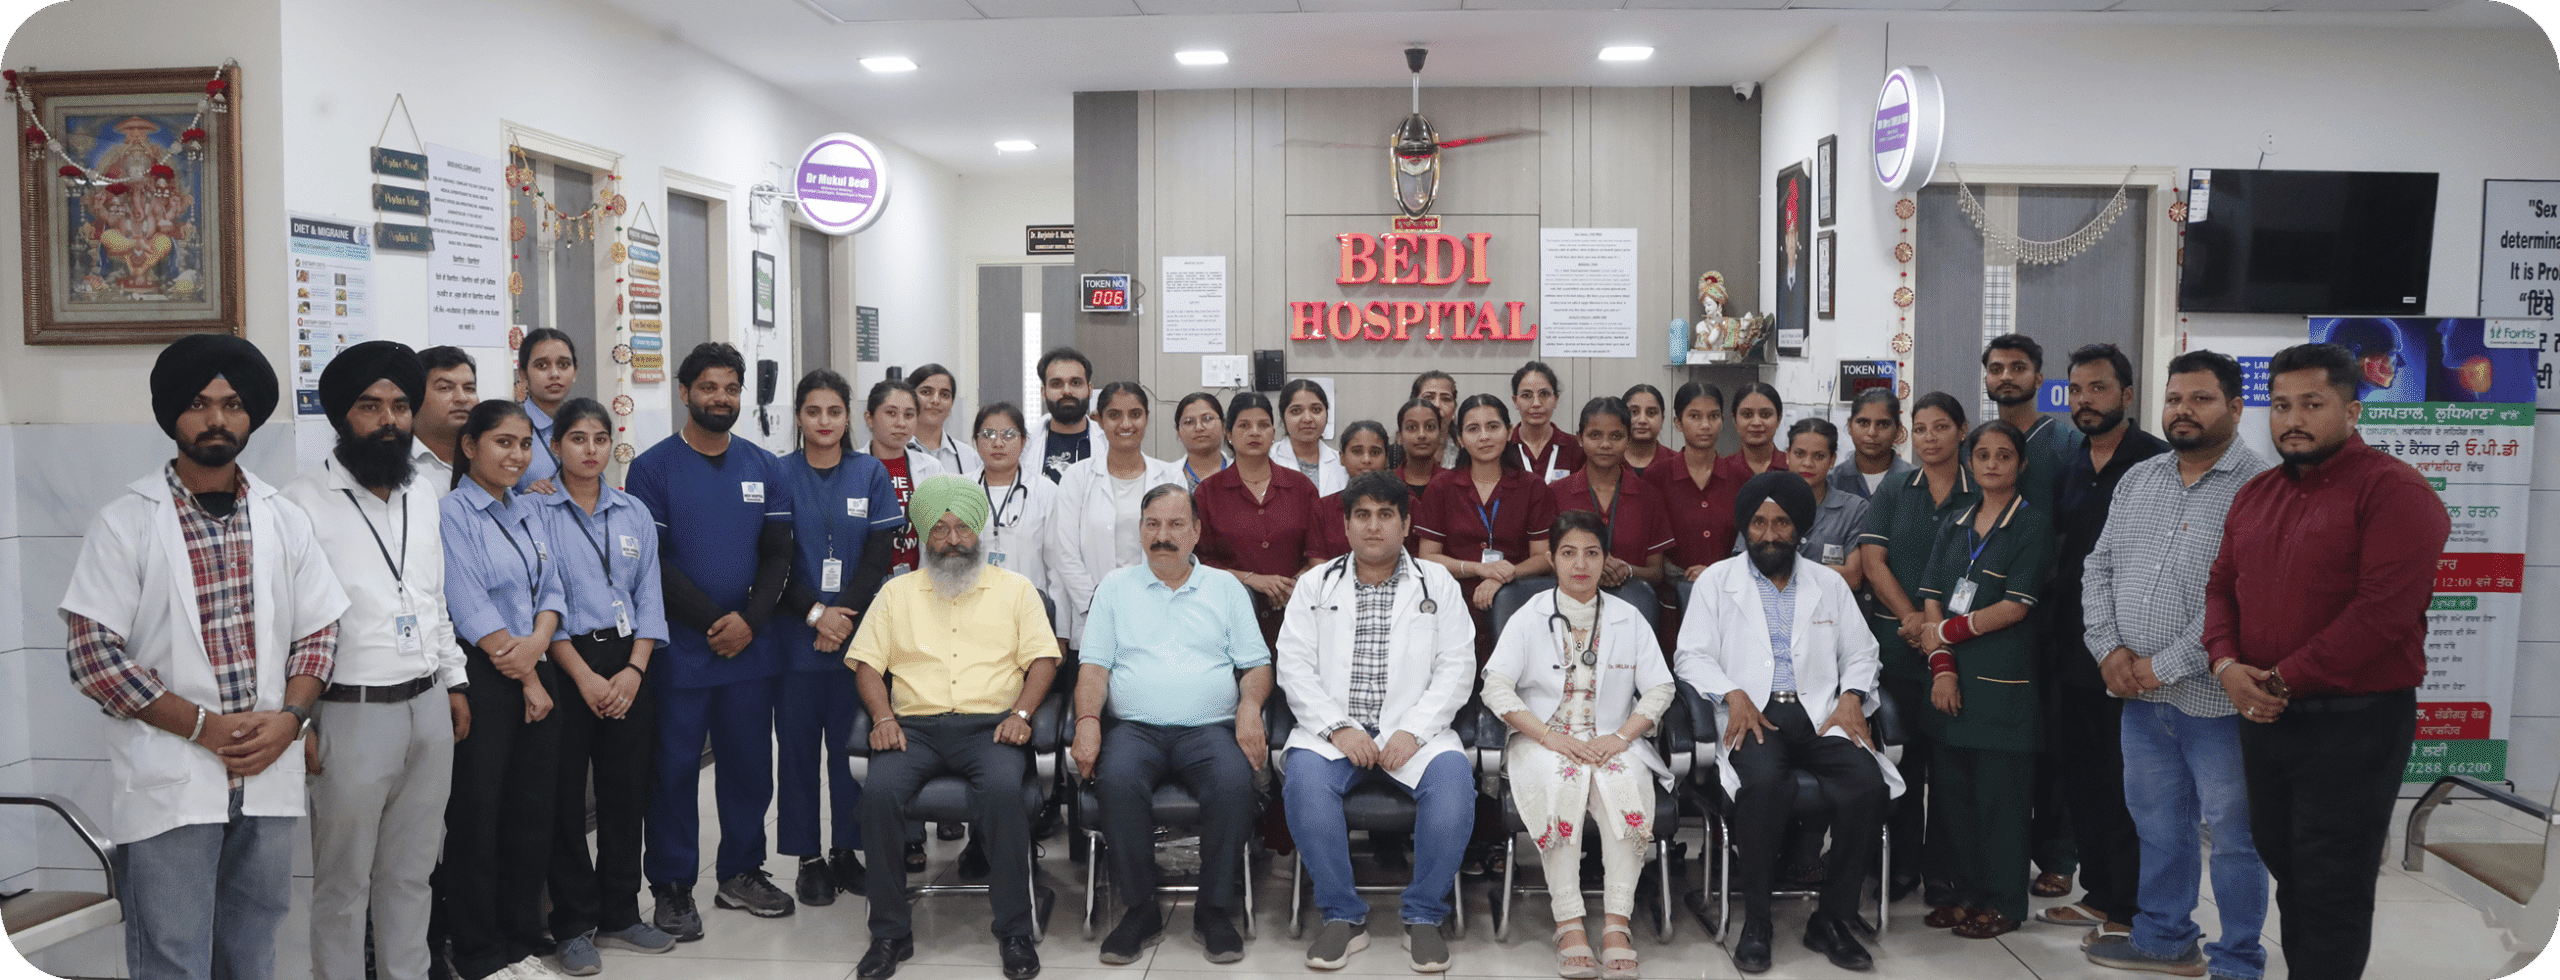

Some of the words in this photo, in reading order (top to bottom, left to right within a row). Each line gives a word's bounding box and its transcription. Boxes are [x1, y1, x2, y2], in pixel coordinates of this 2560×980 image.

[806, 172, 817, 184] Dr
[818, 173, 847, 186] Mukul
[848, 176, 869, 188] Bedi
[2529, 199, 2558, 218] "Sex
[294, 222, 310, 234] DIET
[311, 225, 317, 235] &
[318, 226, 349, 240] MIGRAINE
[1336, 232, 1492, 286] BEDI
[2511, 262, 2519, 280] It
[2523, 262, 2534, 280] is
[2538, 262, 2560, 281] Pro
[1085, 280, 1110, 288] TOKEN
[1093, 291, 1123, 305] 006
[1290, 300, 1538, 341] HOSPITAL
[1843, 365, 1875, 375] TOKEN
[2254, 361, 2269, 370] LAB
[2435, 403, 2495, 423] ਲੁਧਿਆਣਾ
[2394, 440, 2405, 456] ਦੇ
[2409, 439, 2441, 456] ਕੈਂਸਰ
[2445, 440, 2460, 456] ਦੀ
[2467, 506, 2500, 518] ਰਤਨ
[2442, 578, 2472, 587] 12:00
[2422, 743, 2448, 757] ਲਈ
[2448, 762, 2491, 773] 66200
